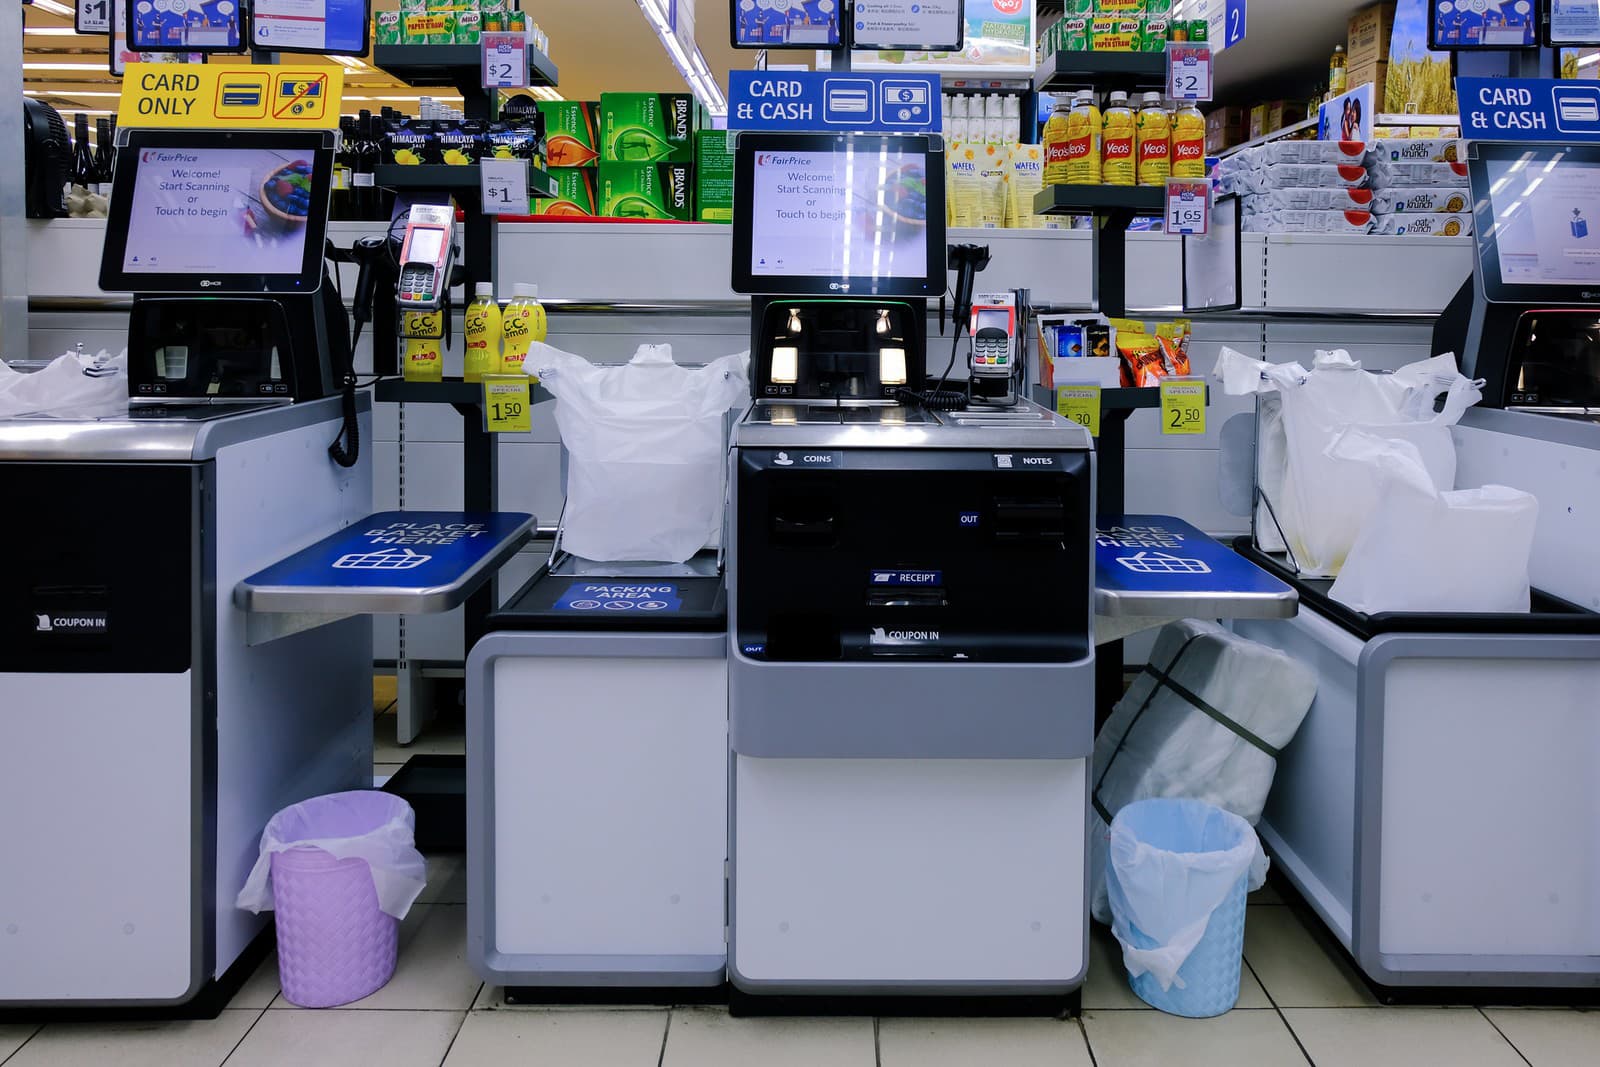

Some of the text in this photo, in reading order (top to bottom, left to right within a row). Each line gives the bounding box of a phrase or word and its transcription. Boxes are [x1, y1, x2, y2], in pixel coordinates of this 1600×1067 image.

[461, 15, 479, 23] MILO
[1147, 23, 1165, 31] MILO
[1231, 8, 1239, 42] 2
[489, 64, 512, 78] $2
[141, 74, 200, 92] CARD
[1175, 76, 1198, 90] $2
[749, 80, 803, 98] CARD
[1479, 88, 1531, 105] CARD
[138, 97, 197, 115] ONLY
[506, 104, 537, 114] HIMALAYA
[648, 97, 656, 127] Essence
[736, 103, 813, 121] & CASH
[570, 106, 578, 134] Essence
[1471, 111, 1546, 129] & CASH
[392, 135, 425, 143] HIMALAYA
[441, 135, 474, 143] HIMALAYA
[1107, 144, 1130, 154] Yeo's
[1144, 144, 1167, 154] Yeo's
[1178, 145, 1200, 155] Yeo's
[1401, 148, 1428, 158] krunch
[157, 153, 198, 162] FairPrice
[771, 156, 812, 166] FairPrice
[952, 162, 975, 171] WAFERS
[1015, 162, 1040, 171] WAFERS
[172, 169, 221, 178] Welcome!
[787, 171, 835, 182] Welcome
[646, 166, 654, 195] Essence
[160, 182, 230, 193] Start Scanning
[571, 172, 579, 200] Essence
[776, 184, 801, 193] Start
[187, 196, 198, 204] or
[488, 187, 512, 203] $1
[1415, 194, 1428, 202] oat
[806, 198, 817, 207] or
[1407, 199, 1433, 209] krunch
[155, 207, 228, 218] Touch to begin
[775, 209, 846, 221] Touch to begin
[1171, 209, 1202, 226] 1.65
[1415, 218, 1428, 226] oat
[1407, 223, 1431, 233] krunch
[411, 316, 434, 330] C.C.
[466, 317, 484, 329] C.C.
[504, 318, 525, 332] C.C.
[491, 402, 522, 421] 1.50
[1170, 408, 1200, 428] 2.50
[803, 455, 832, 463] COINS
[1023, 457, 1053, 465] NOTES
[960, 515, 978, 524] OUT
[387, 522, 485, 531] PLACE
[1096, 526, 1169, 534] LACE
[363, 529, 488, 538] BASKET
[1096, 533, 1185, 541] ASKET
[369, 536, 460, 545] HERE
[1097, 540, 1182, 548] HERE
[899, 573, 935, 583] RECEIPT
[53, 616, 105, 628] COUPON IN
[889, 630, 939, 641] COUPON IN
